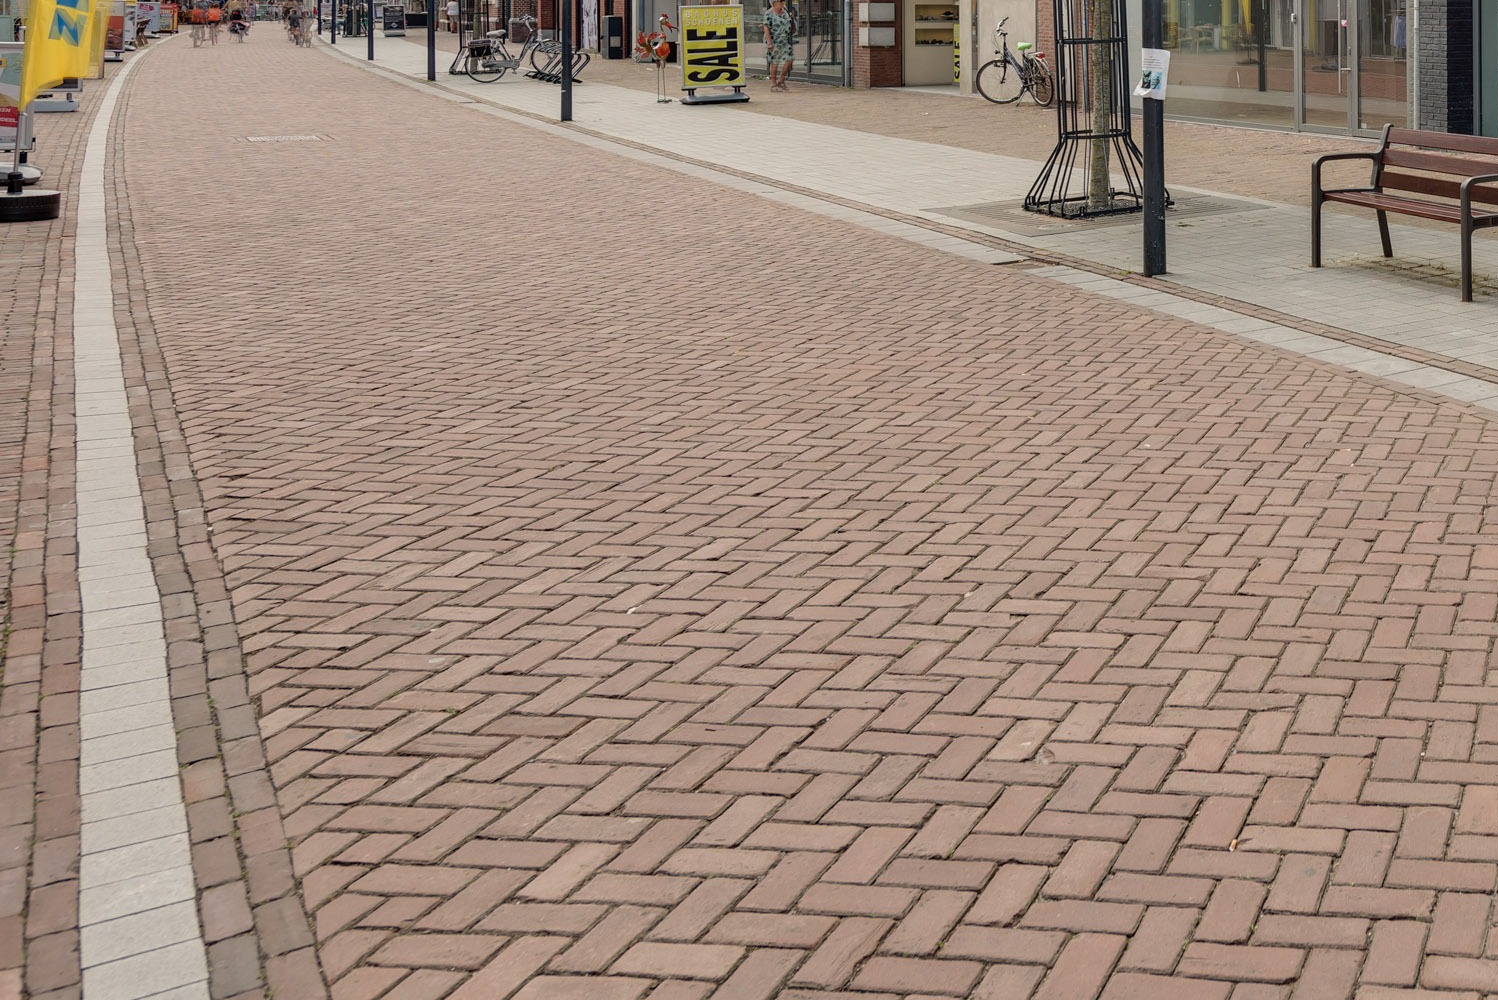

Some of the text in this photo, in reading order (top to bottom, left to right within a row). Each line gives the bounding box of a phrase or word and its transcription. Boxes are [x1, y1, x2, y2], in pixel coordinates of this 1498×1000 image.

[685, 9, 738, 18] BAGHUS
[685, 17, 739, 26] SCHOENEN
[686, 27, 740, 82] SALE
